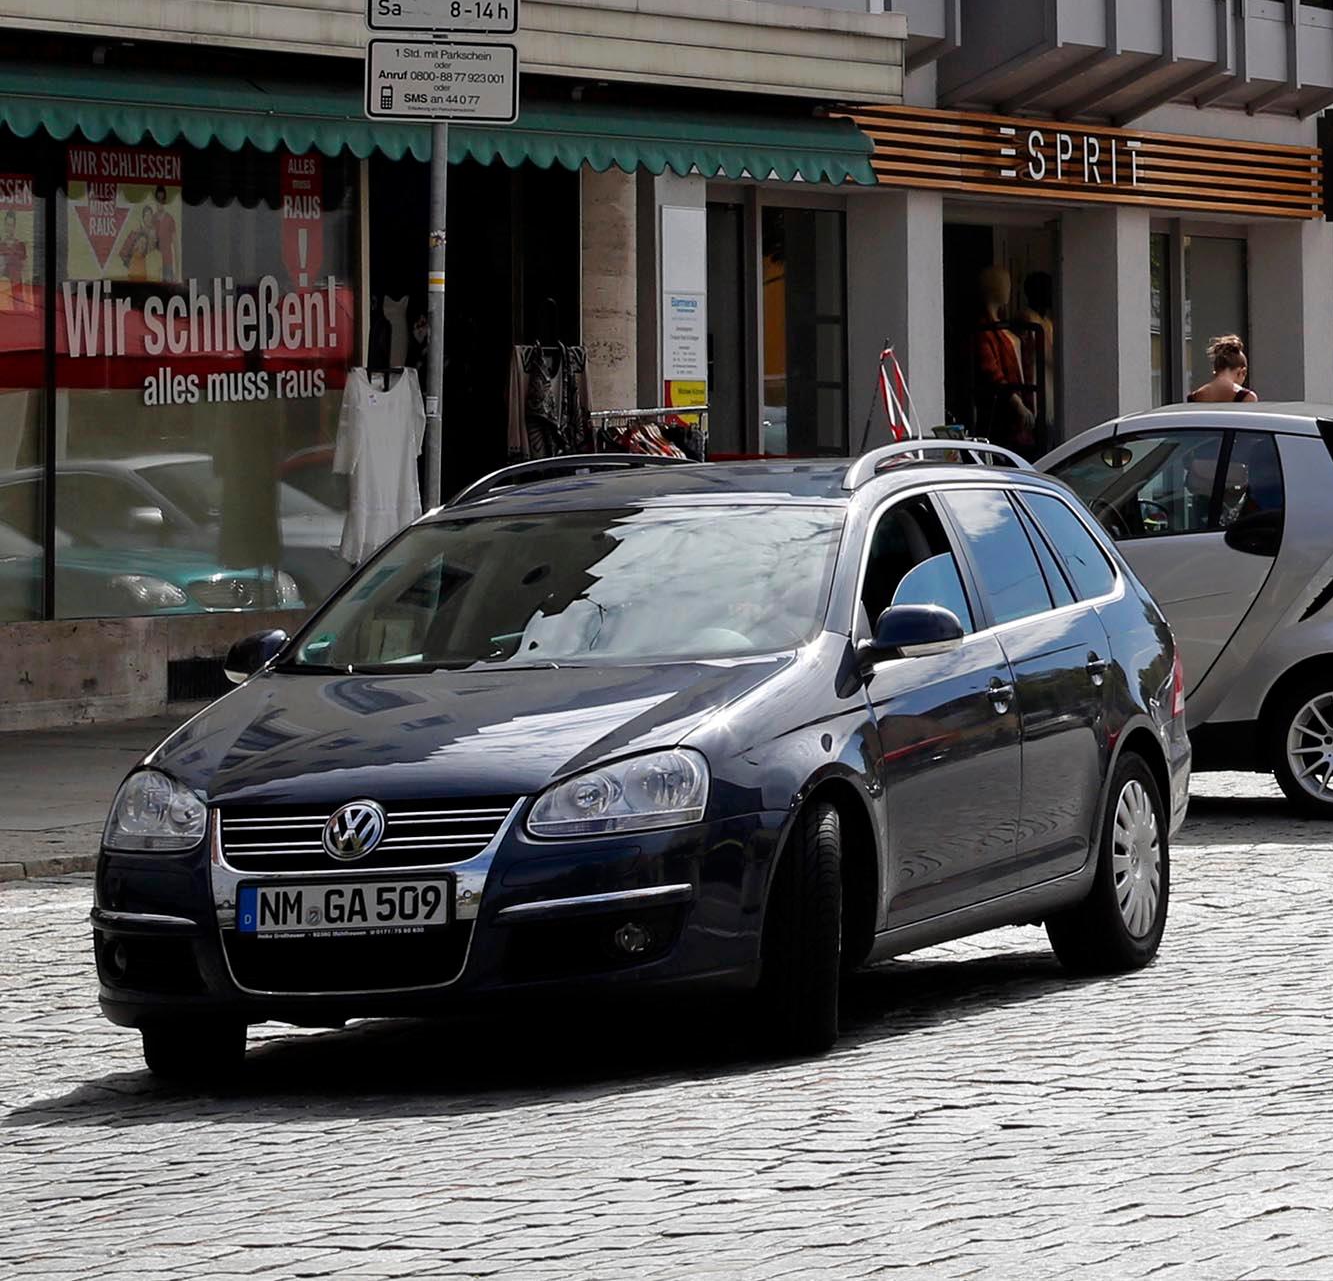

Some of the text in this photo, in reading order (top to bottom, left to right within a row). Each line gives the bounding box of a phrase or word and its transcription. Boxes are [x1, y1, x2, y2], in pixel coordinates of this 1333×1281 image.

[395, 48, 492, 61] 1 Std. mit Parkschein
[433, 61, 452, 69] oder
[378, 70, 408, 80] Anruf
[433, 84, 452, 92] oder
[404, 93, 428, 104] SMS
[430, 96, 444, 104] an
[69, 149, 181, 182] WIR SCHLIESSEN
[999, 126, 1142, 187] ESPRIT
[287, 158, 316, 175] ALLES
[89, 181, 116, 200] ALLES
[89, 200, 116, 217] MUSS
[283, 195, 321, 220] RAUS
[88, 217, 117, 238] RAUS
[62, 274, 337, 358] Wir schließen!
[143, 367, 326, 406] alles muss raus
[259, 891, 303, 927] NM
[324, 888, 368, 924] GA
[375, 885, 442, 922] 509
